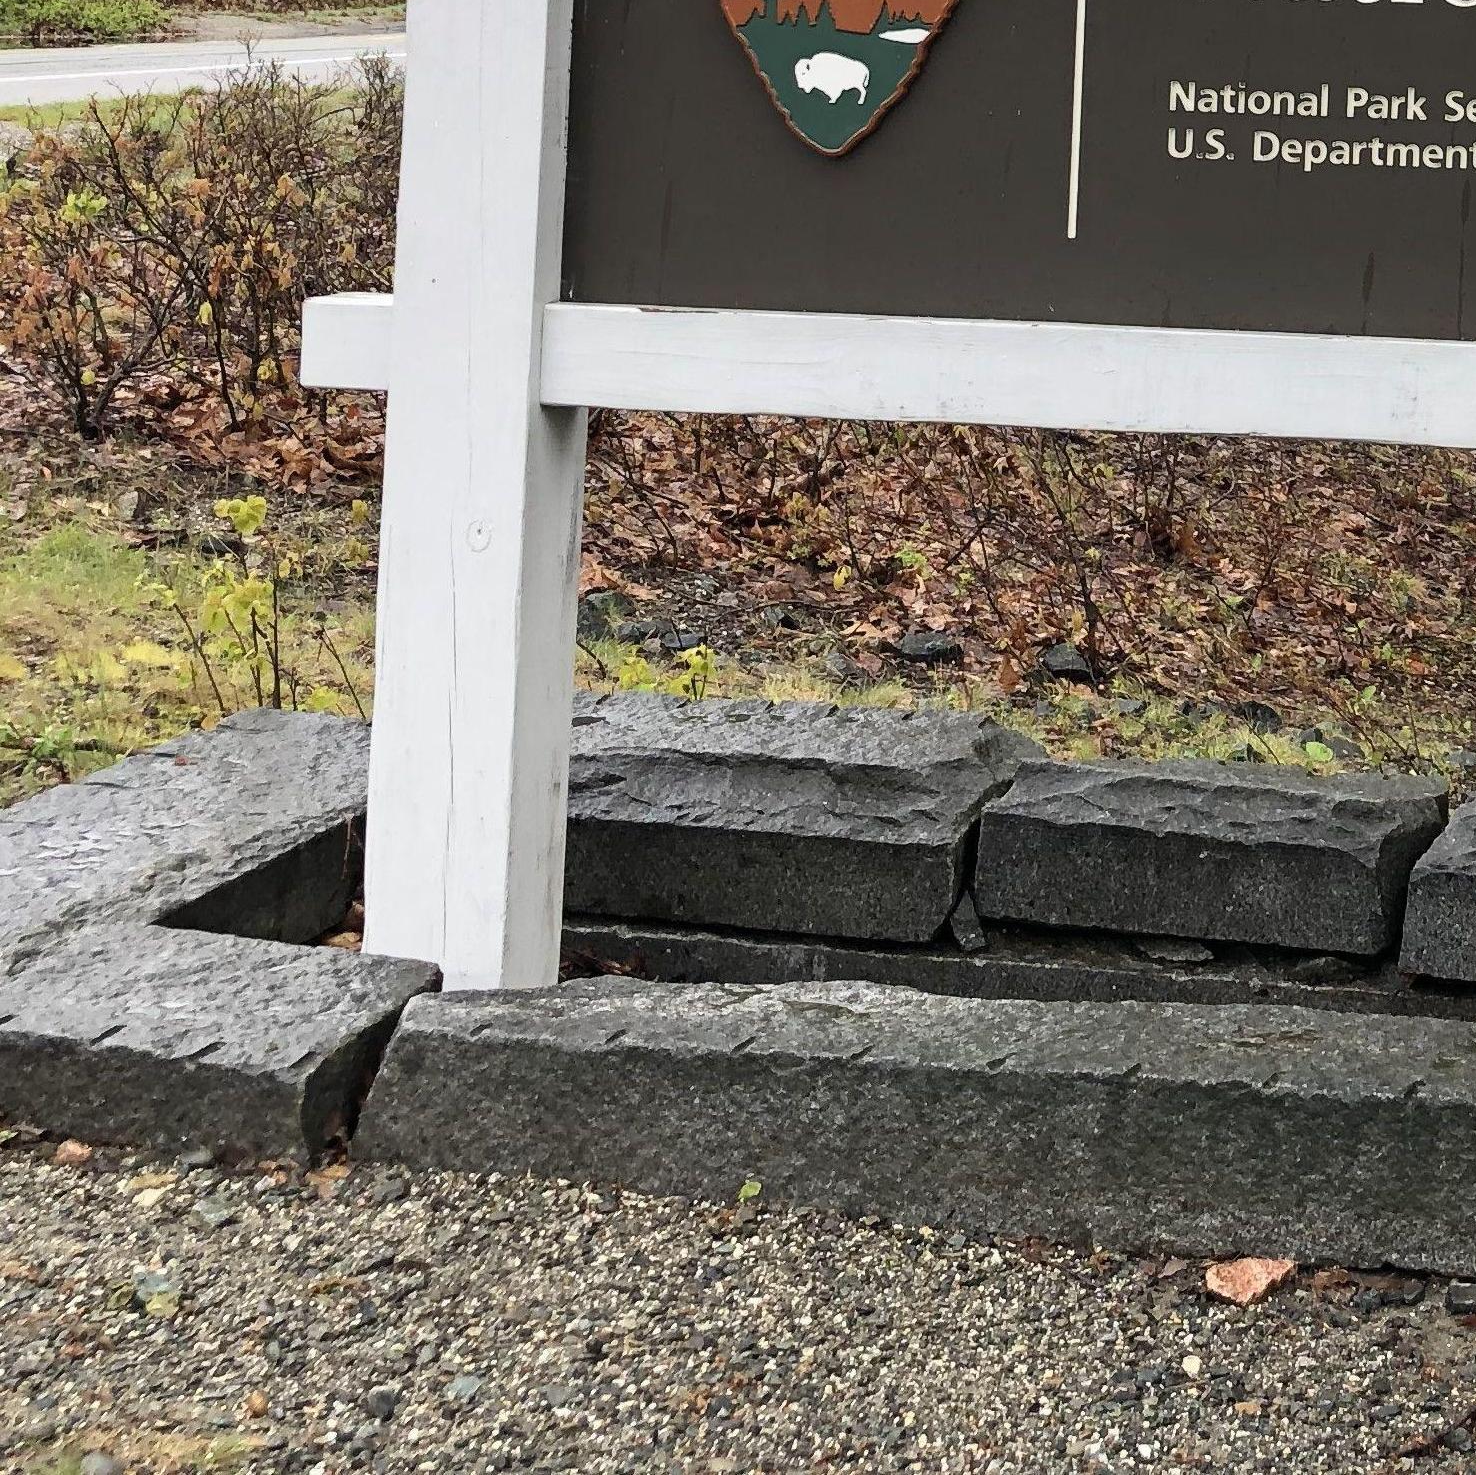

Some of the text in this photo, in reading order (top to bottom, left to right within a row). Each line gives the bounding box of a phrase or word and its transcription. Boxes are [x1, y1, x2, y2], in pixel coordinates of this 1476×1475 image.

[1169, 80, 1329, 118] National
[1346, 87, 1428, 121] Park
[1167, 127, 1235, 162] U.S.
